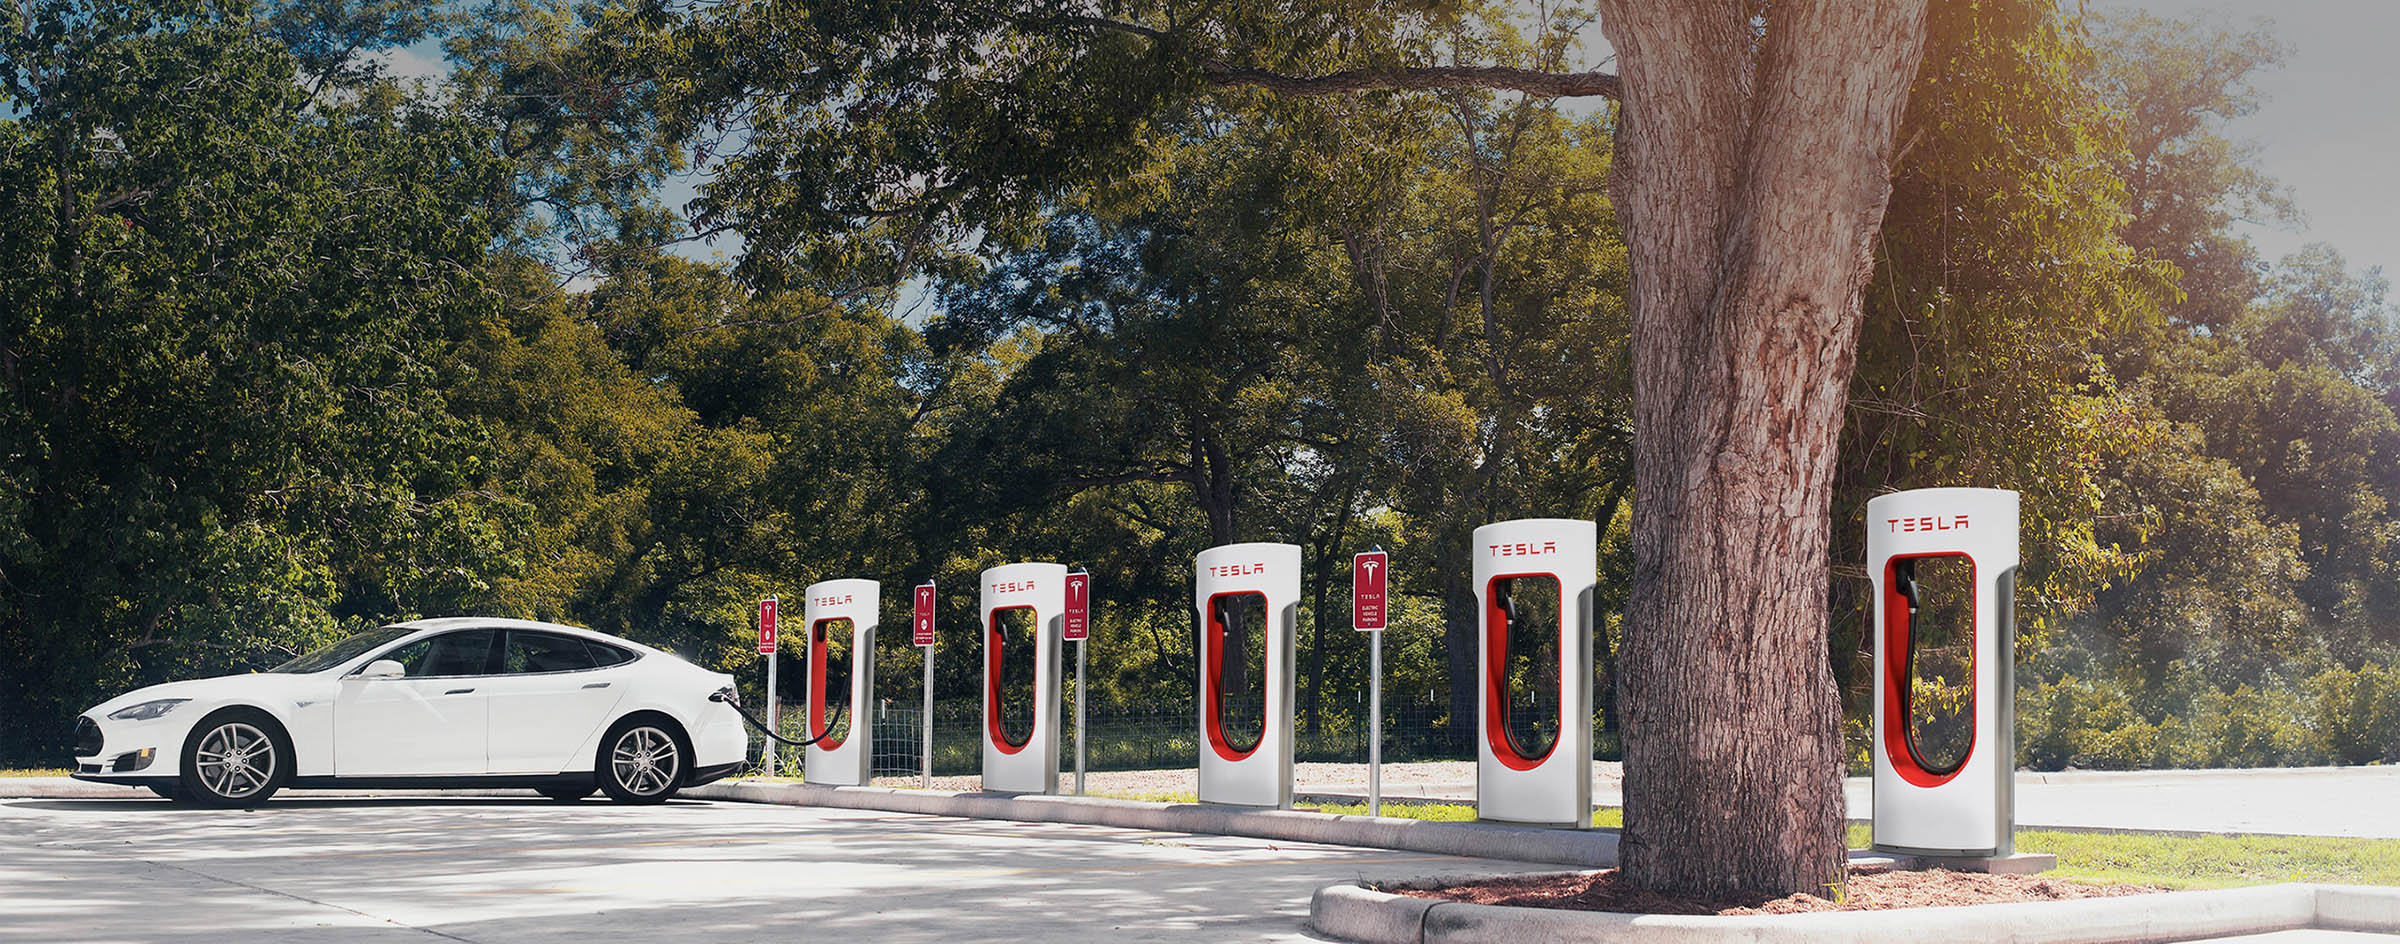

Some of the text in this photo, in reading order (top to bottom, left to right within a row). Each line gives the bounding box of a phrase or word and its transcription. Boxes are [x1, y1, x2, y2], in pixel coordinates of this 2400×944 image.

[1888, 515, 1968, 533] TESLA
[1489, 542, 1555, 557] TESLA
[1209, 563, 1264, 577] TESLA
[992, 581, 1035, 593] TESLA
[814, 595, 852, 606] TESLA
